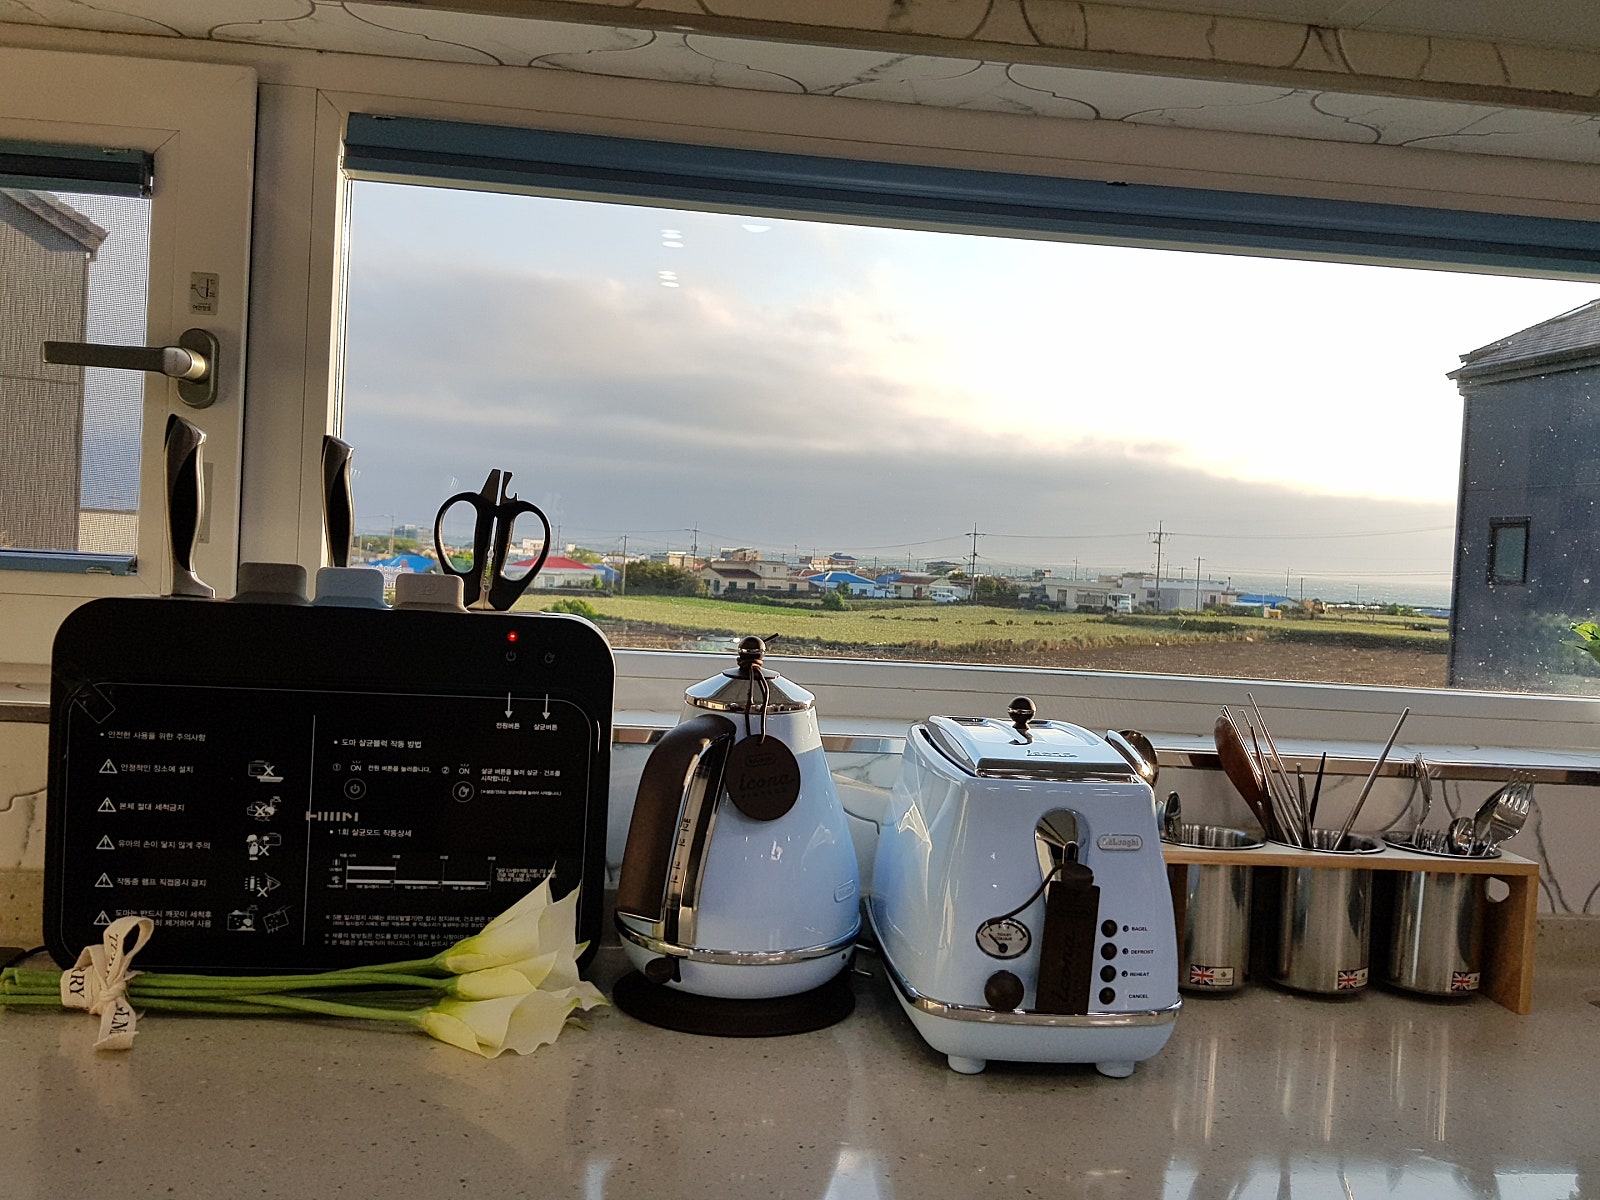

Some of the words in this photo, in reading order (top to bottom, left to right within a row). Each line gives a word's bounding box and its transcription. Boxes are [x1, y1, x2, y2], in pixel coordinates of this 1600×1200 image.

[133, 732, 155, 740] 사용을
[159, 732, 173, 740] 위한
[176, 733, 206, 741] 주의사항
[390, 740, 404, 748] 작동
[121, 764, 150, 772] 안정적인
[458, 767, 470, 775] ON
[155, 804, 184, 812] 세척금지
[191, 879, 207, 887] 금지
